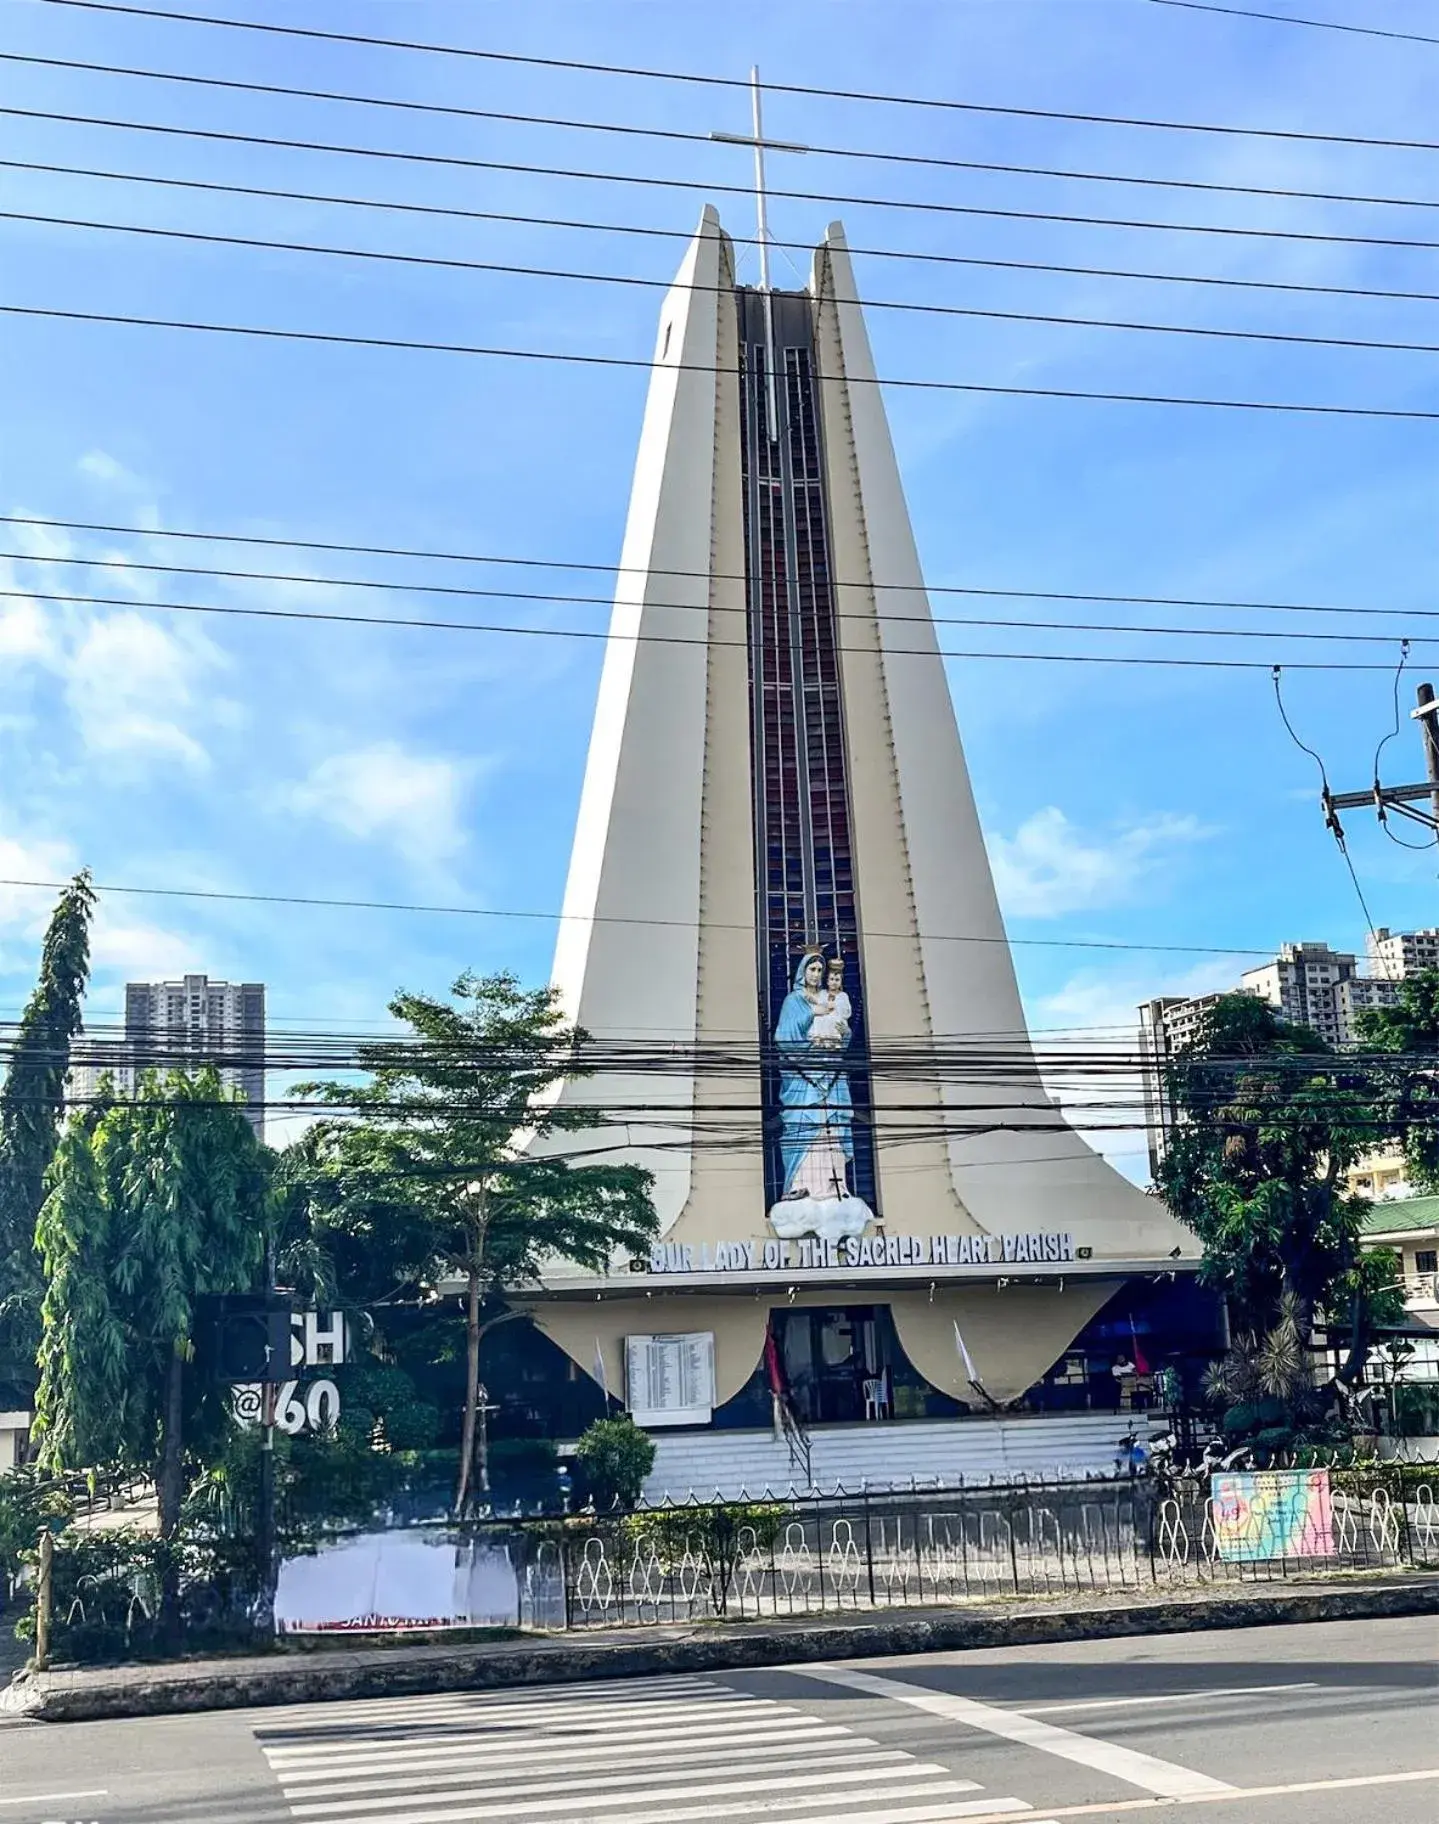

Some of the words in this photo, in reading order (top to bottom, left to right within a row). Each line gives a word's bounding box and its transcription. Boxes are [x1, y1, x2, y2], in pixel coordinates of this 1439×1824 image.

[651, 1241, 692, 1272] OUR
[700, 1239, 755, 1271] LADY
[763, 1239, 791, 1269] OF
[797, 1237, 840, 1267] THE
[846, 1235, 924, 1266] SACRED
[932, 1234, 994, 1264] HEART
[1003, 1231, 1073, 1262] PARISH
[274, 1379, 341, 1435] 60
